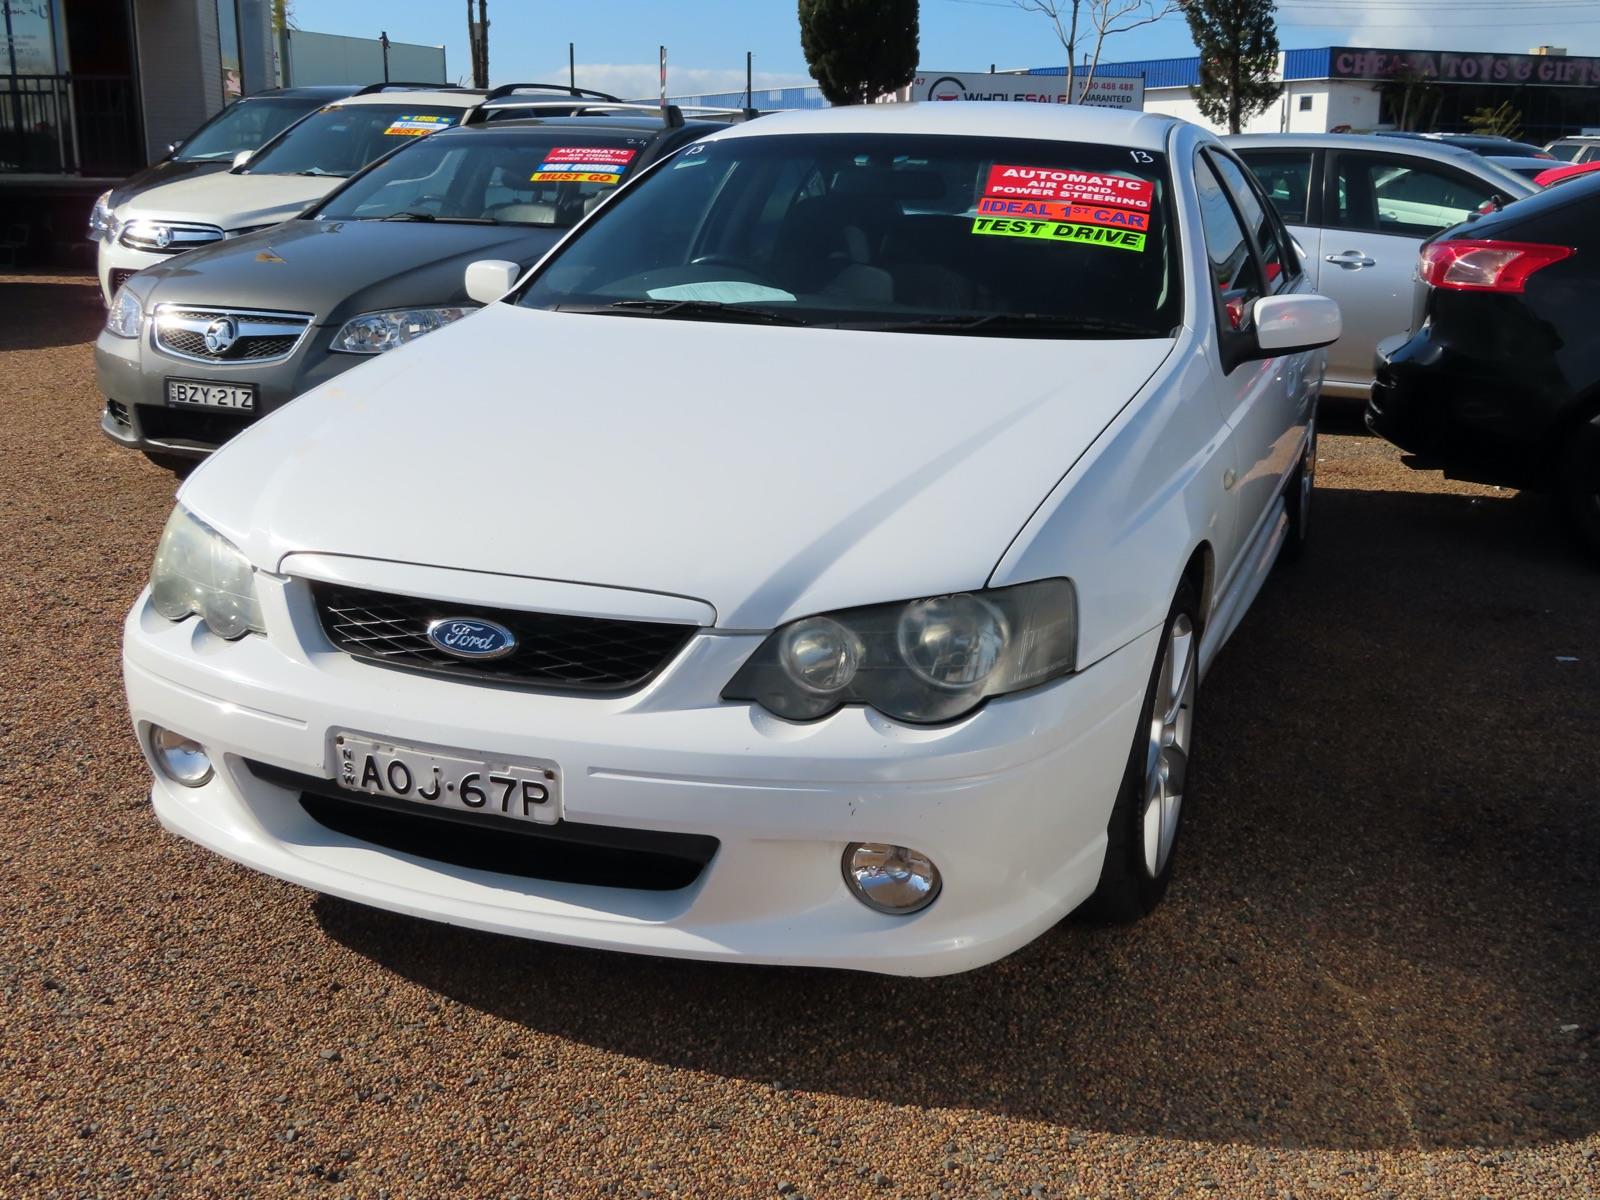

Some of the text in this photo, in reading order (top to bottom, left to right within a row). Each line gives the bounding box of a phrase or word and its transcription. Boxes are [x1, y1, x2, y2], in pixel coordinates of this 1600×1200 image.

[1447, 58, 1509, 81] TOYS
[1513, 61, 1532, 81] &
[1537, 61, 1600, 82] GIFTS
[1129, 150, 1154, 164] 13
[538, 173, 612, 182] MUST GO
[1002, 168, 1142, 191] AUTOMATIC
[1028, 180, 1116, 195] AIR COND.
[992, 186, 1148, 208] POWER STEERING
[981, 200, 1145, 228] IDEAL 1ST CAR
[977, 218, 1142, 246] TEST DRIVE
[445, 623, 495, 650] Ford
[343, 748, 356, 786] NSW
